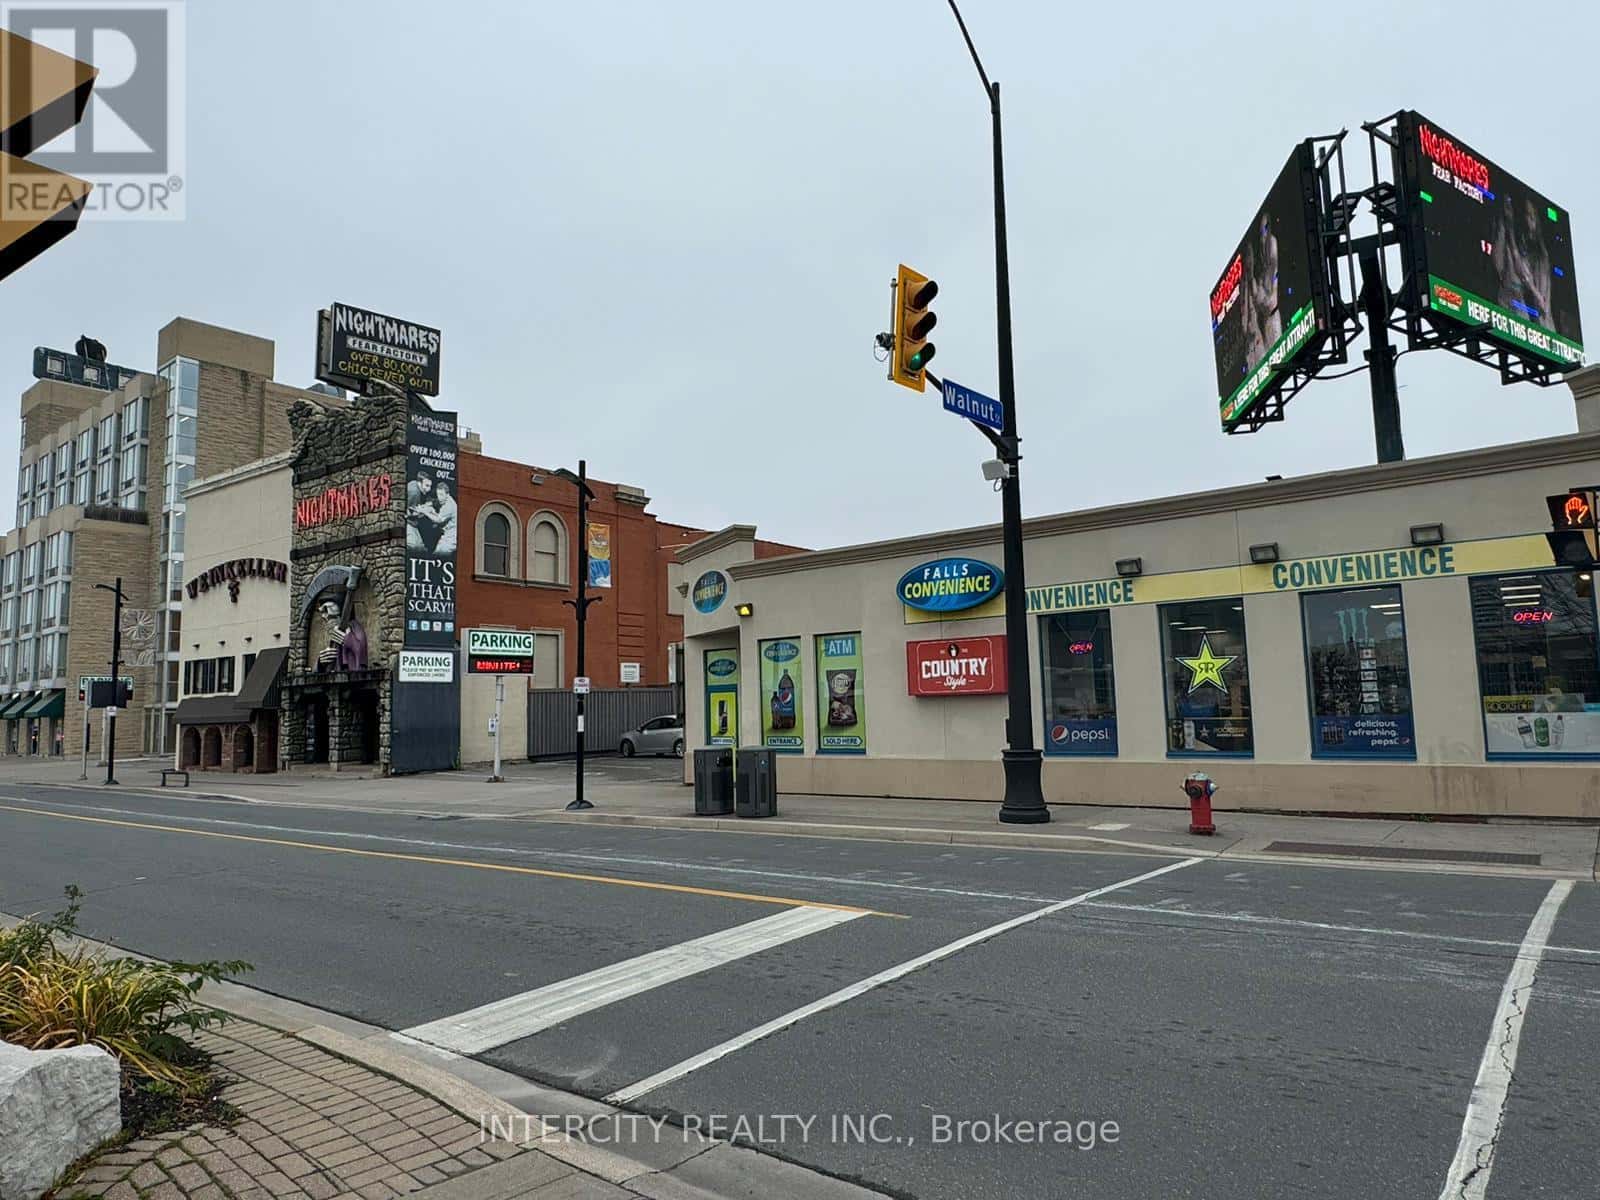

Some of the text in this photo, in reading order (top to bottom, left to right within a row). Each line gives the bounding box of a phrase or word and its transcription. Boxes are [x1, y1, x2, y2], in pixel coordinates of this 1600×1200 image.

[336, 305, 439, 355] NIGHTMARES
[1491, 311, 1509, 334] FOR
[1508, 318, 1527, 341] THIS
[1527, 328, 1551, 351] GREAT
[351, 338, 425, 364] FEAR FACTORY
[350, 352, 380, 368] OVER
[338, 361, 405, 384] CHICKENED
[944, 384, 995, 422] Walnut
[410, 445, 428, 455] OVER
[420, 456, 455, 470] CHICKENED
[296, 472, 392, 528] NIGHTMARES
[409, 558, 454, 585] IT'S
[924, 563, 969, 580] FALLS
[1273, 546, 1456, 589] CONVENIENCE
[409, 582, 454, 600] THAT
[904, 575, 991, 599] CONVENIENCE
[1512, 611, 1553, 623] OPEN
[471, 633, 532, 648] PARKING
[828, 639, 852, 655] ATM
[1069, 642, 1094, 654] OPEN
[402, 656, 451, 667] PARKING
[921, 657, 988, 679] COUNTRY
[944, 676, 966, 689] Style
[769, 737, 798, 745] ENTRANCE
[1071, 728, 1109, 743] pepsi
